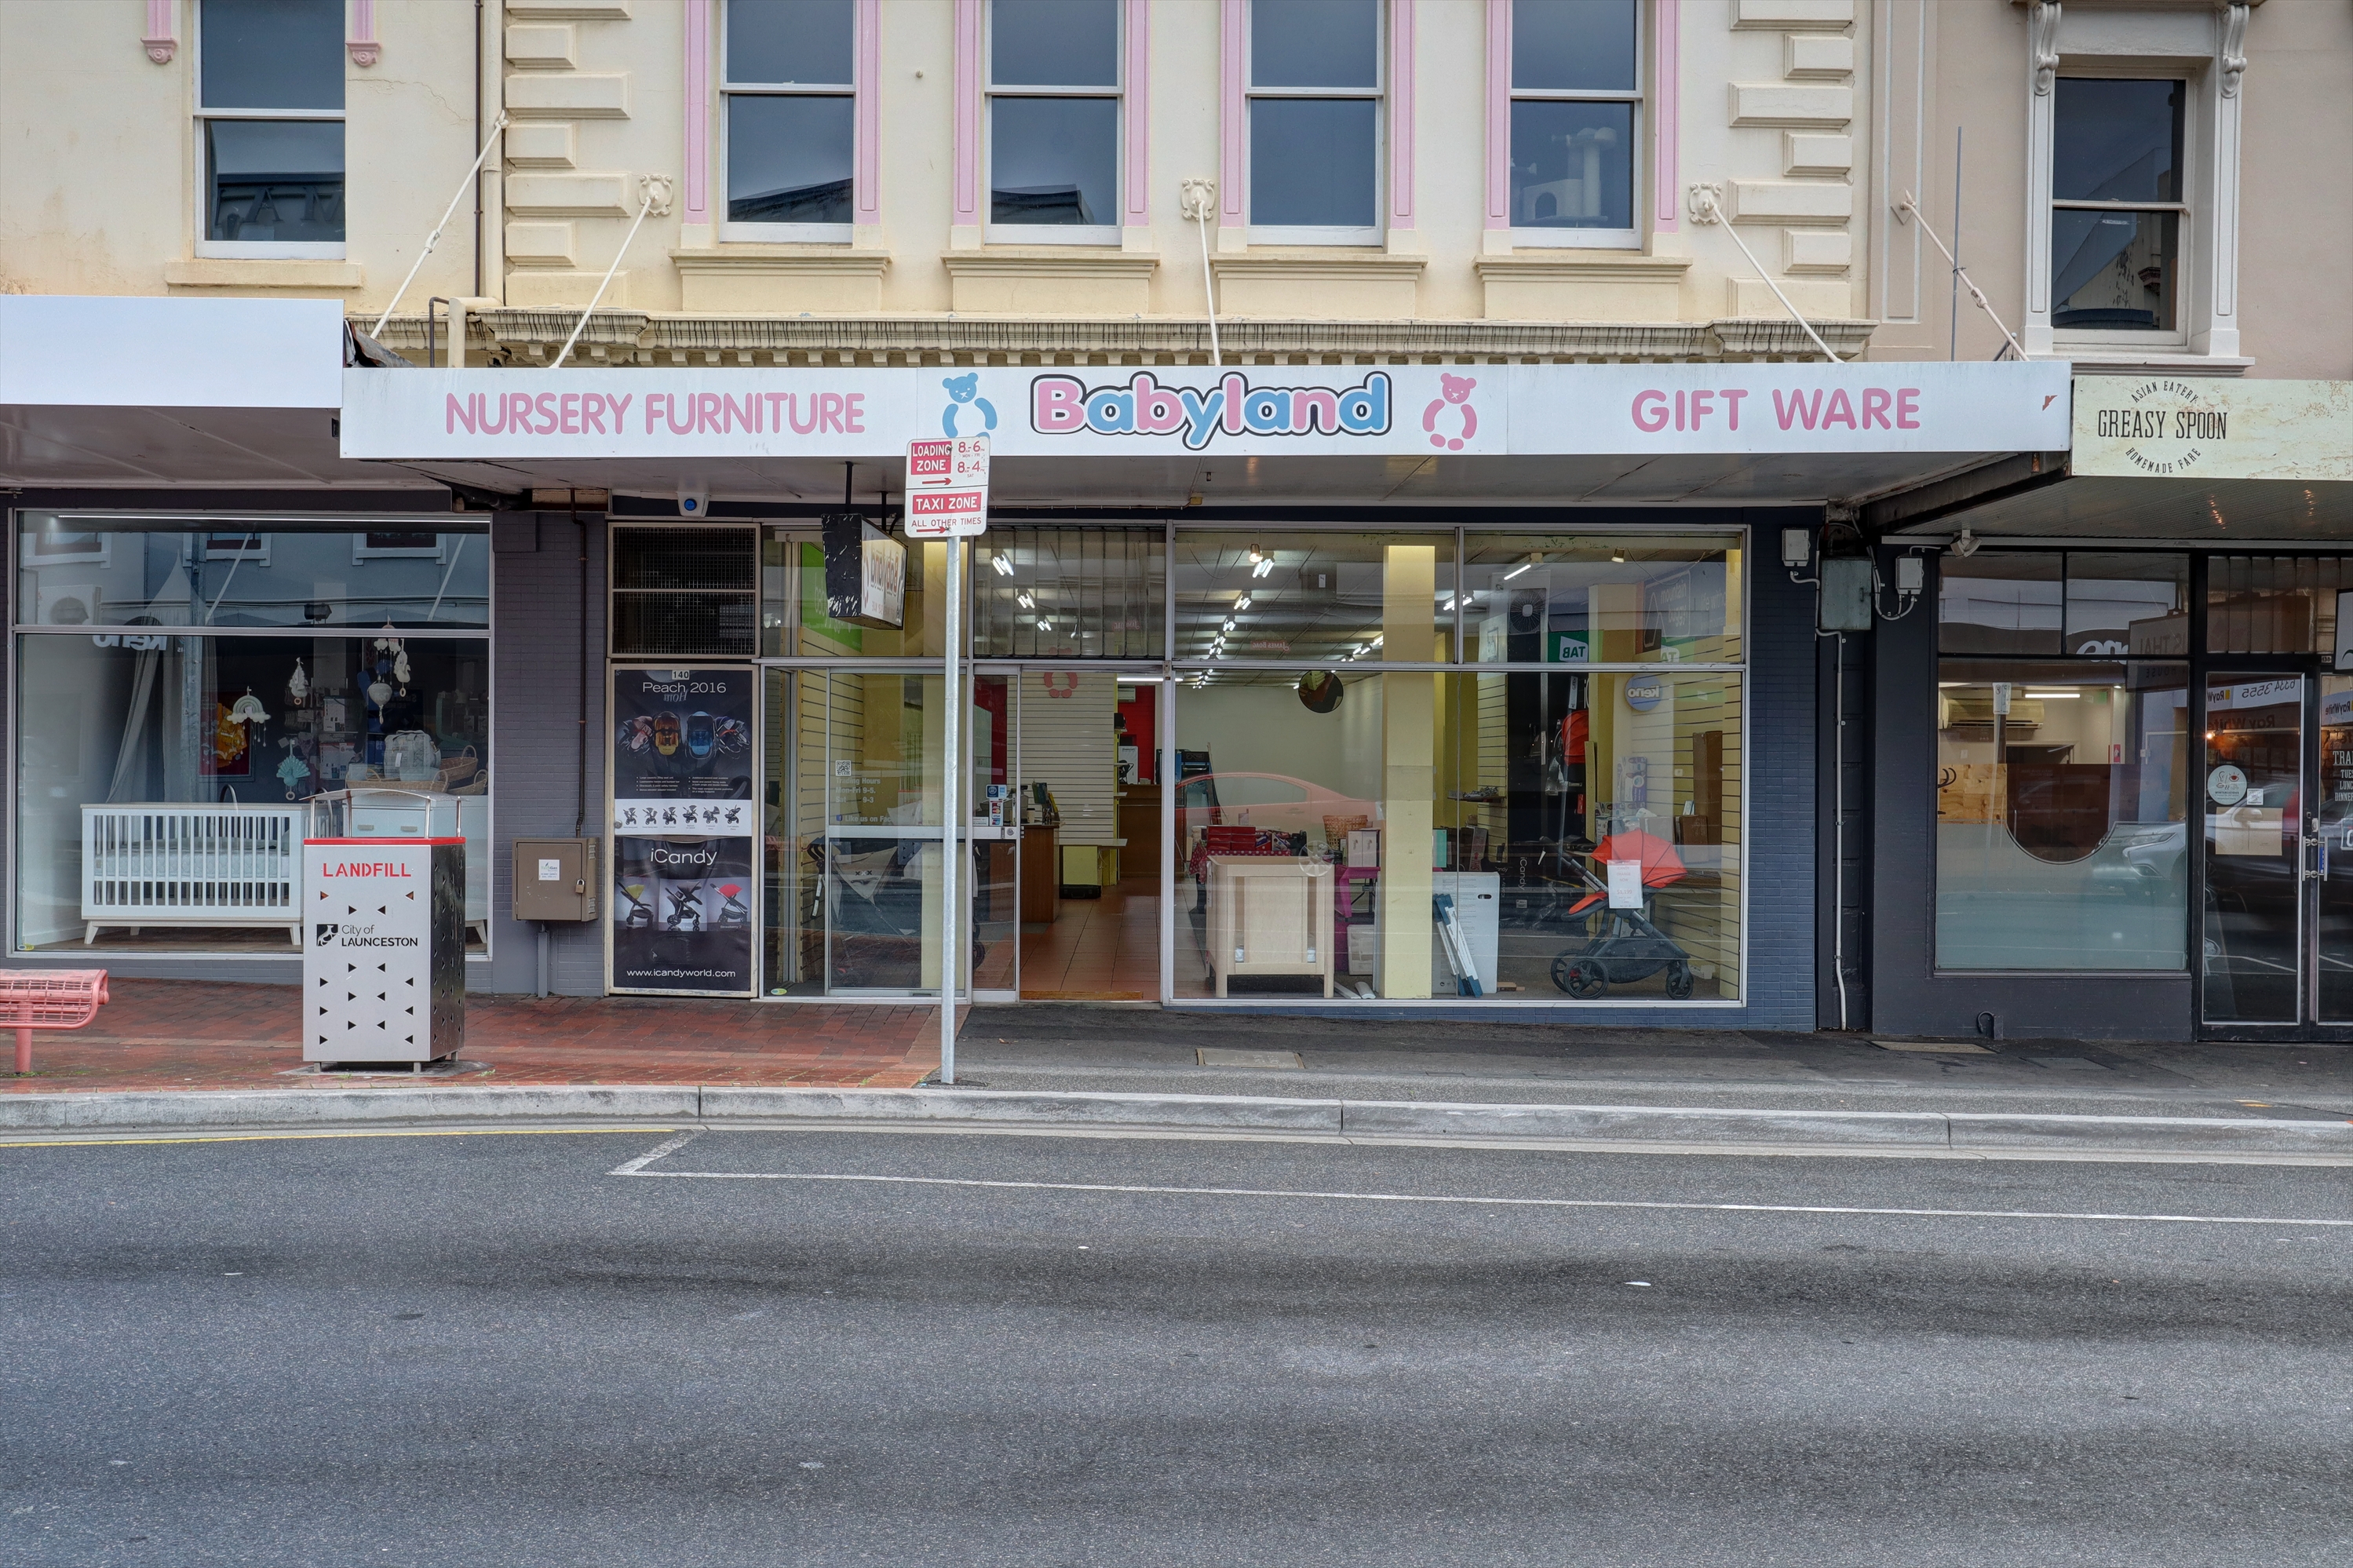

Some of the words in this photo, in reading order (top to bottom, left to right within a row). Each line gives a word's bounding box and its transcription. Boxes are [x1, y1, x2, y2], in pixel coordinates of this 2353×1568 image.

[2131, 381, 2158, 403] ASIAN
[2163, 381, 2199, 403] EATERY
[446, 392, 633, 436] NURSERY
[645, 392, 866, 435] FURNITURE
[1031, 370, 1392, 450] Babyland
[1630, 388, 1749, 433] GIFT
[1771, 387, 1921, 432] WARE
[2098, 410, 2167, 439] GREASY
[2176, 411, 2228, 440] SPOON
[912, 444, 951, 458] LOADING
[916, 459, 947, 472] ZONE
[2125, 447, 2173, 475] HOMEMADE
[2177, 447, 2202, 470] FARE
[915, 498, 944, 511] TAXI
[948, 496, 978, 510] ZONE
[931, 518, 958, 527] OTHER
[960, 517, 982, 526] TIMES
[642, 682, 686, 693] Peach
[690, 682, 727, 693] 2016
[2333, 750, 2353, 764] TRA
[835, 777, 860, 786] Trading
[2340, 780, 2353, 790] LUNC
[2334, 792, 2353, 802] DINNE
[650, 848, 717, 866] iCandy
[322, 862, 412, 877] LANDFILL
[1518, 856, 1528, 891] iCandy
[341, 924, 362, 936] City
[363, 924, 375, 935] of
[341, 937, 418, 947] LAUNCESTON
[626, 968, 737, 979] www.icandyworld.com
